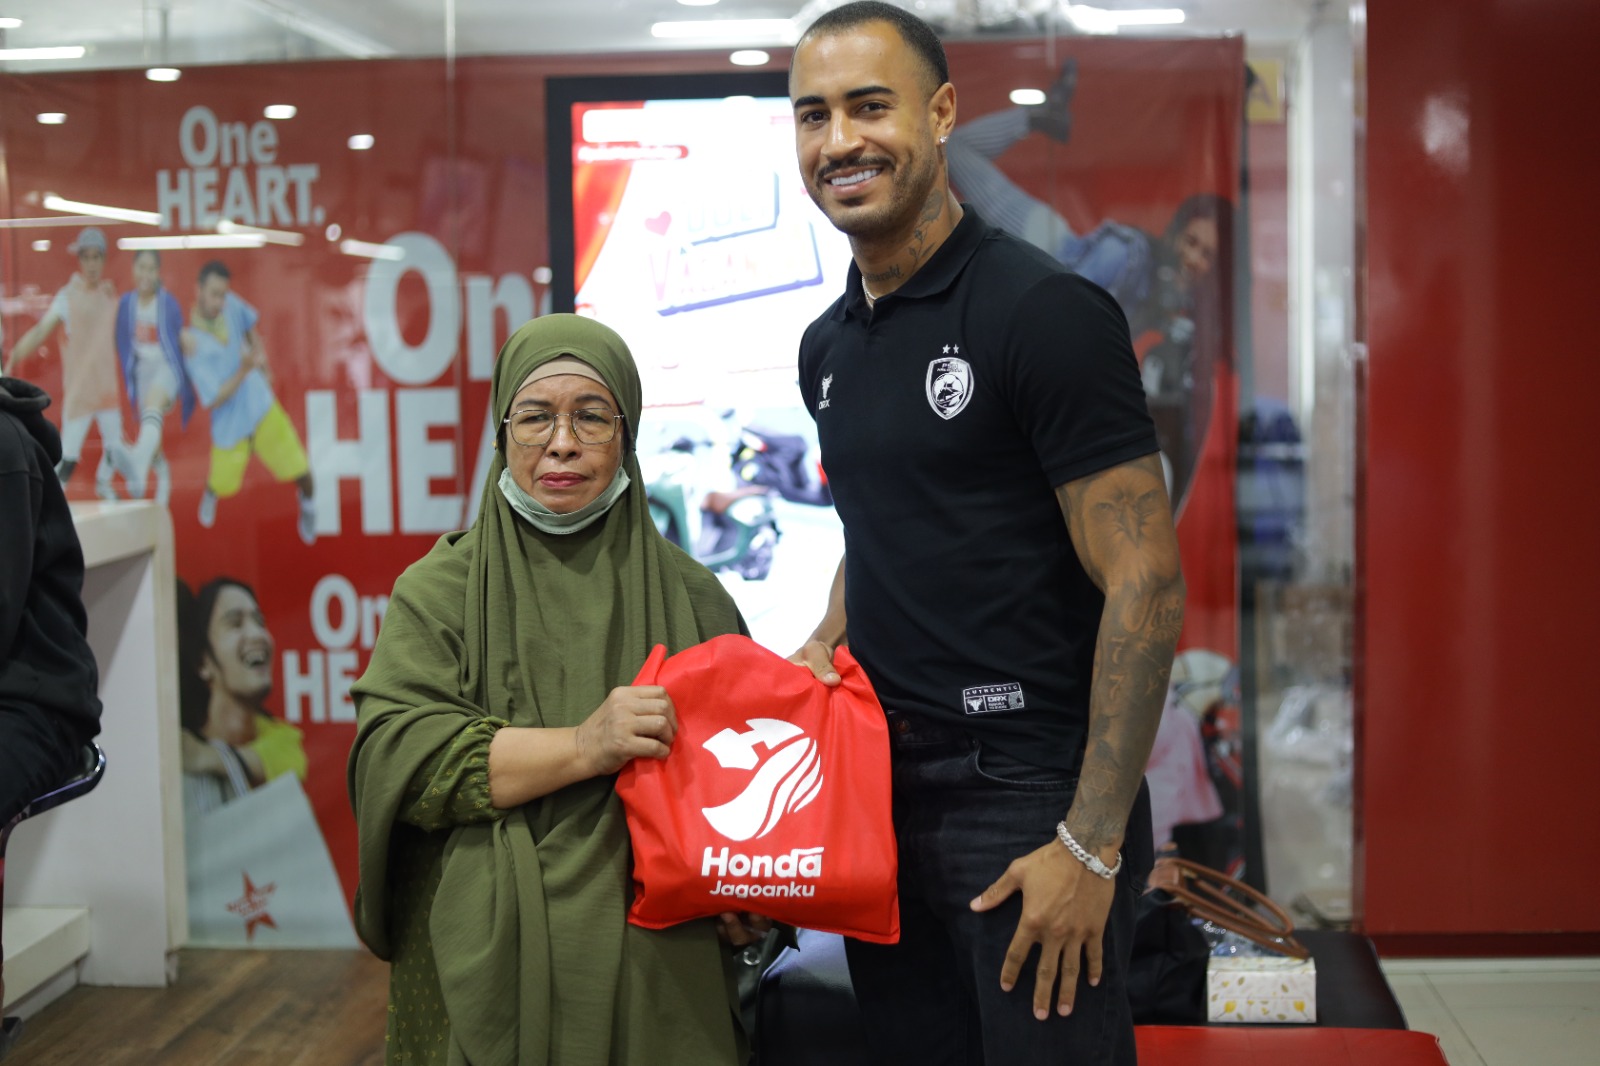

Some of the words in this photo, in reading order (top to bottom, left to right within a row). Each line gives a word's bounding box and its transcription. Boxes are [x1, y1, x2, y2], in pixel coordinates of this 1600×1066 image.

[180, 107, 277, 167] One
[157, 164, 324, 229] HEART.
[364, 232, 551, 386] On
[966, 685, 1018, 695] AUTHENTIC
[987, 695, 1007, 703] DRX
[701, 847, 824, 878] Honda
[710, 880, 815, 898] Jagoanku
